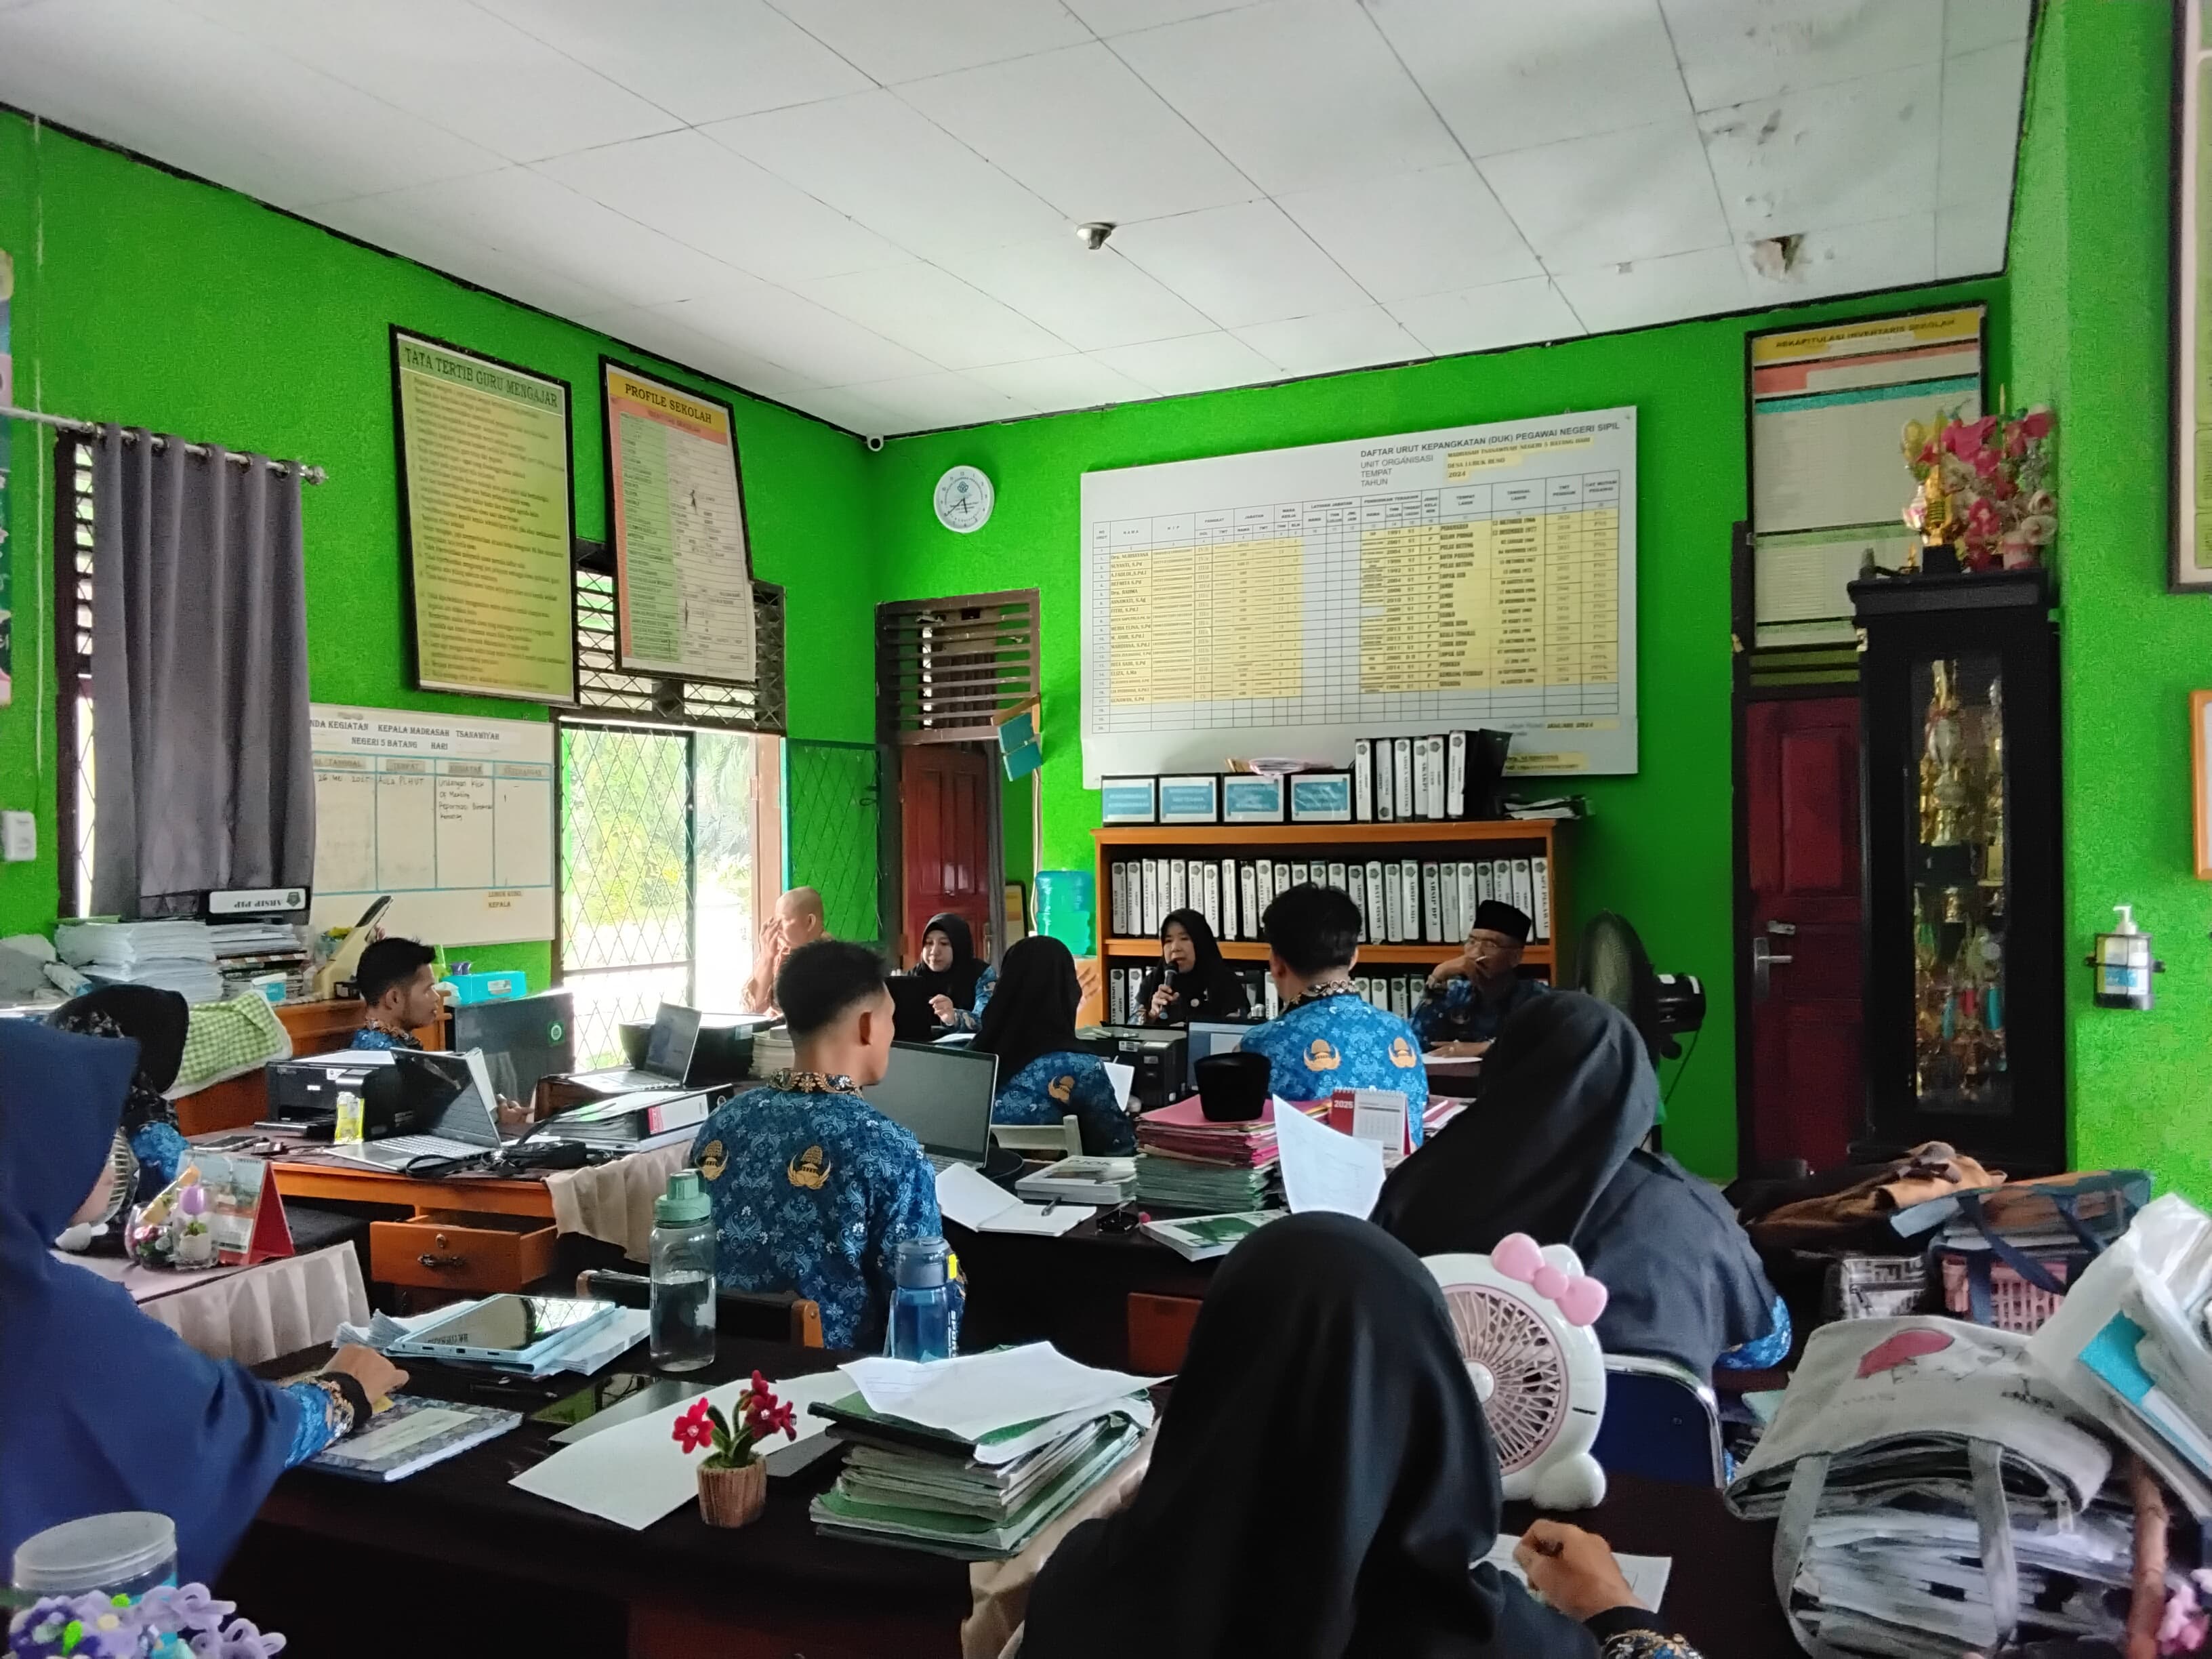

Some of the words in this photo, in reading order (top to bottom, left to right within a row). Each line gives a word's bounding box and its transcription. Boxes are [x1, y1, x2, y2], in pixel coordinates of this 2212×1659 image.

[405, 348, 433, 369] TATA
[436, 357, 473, 382] TERTIB
[476, 371, 503, 390] GURU
[506, 380, 558, 407] MENGAJAR
[625, 384, 667, 407] PROFILE
[670, 400, 712, 424] SEKOLAH
[1361, 447, 1393, 457] DAFTAR
[1396, 445, 1419, 453] URUT
[1421, 437, 1486, 450] KEPANGKATAN
[1488, 434, 1513, 445] (DUK)
[1516, 430, 1557, 441] PEGAWAI
[1559, 426, 1595, 435] NEGERI
[1598, 422, 1620, 431] SIPIL
[1361, 460, 1378, 468] UNIT
[1381, 455, 1434, 466] ORGANISASI
[1361, 468, 1393, 478] TEMPAT
[1361, 478, 1388, 488] TAHUN
[309, 720, 326, 729] NDA
[328, 720, 369, 731] KEGIATAN
[378, 724, 408, 734] KEPALA
[410, 727, 449, 737] MADRASAH
[455, 730, 499, 740] TSANAWIYAH
[352, 737, 380, 746] NEGERI
[387, 739, 417, 748] BATANG
[430, 742, 448, 750] HARI
[1334, 1100, 1354, 1109] 2025
